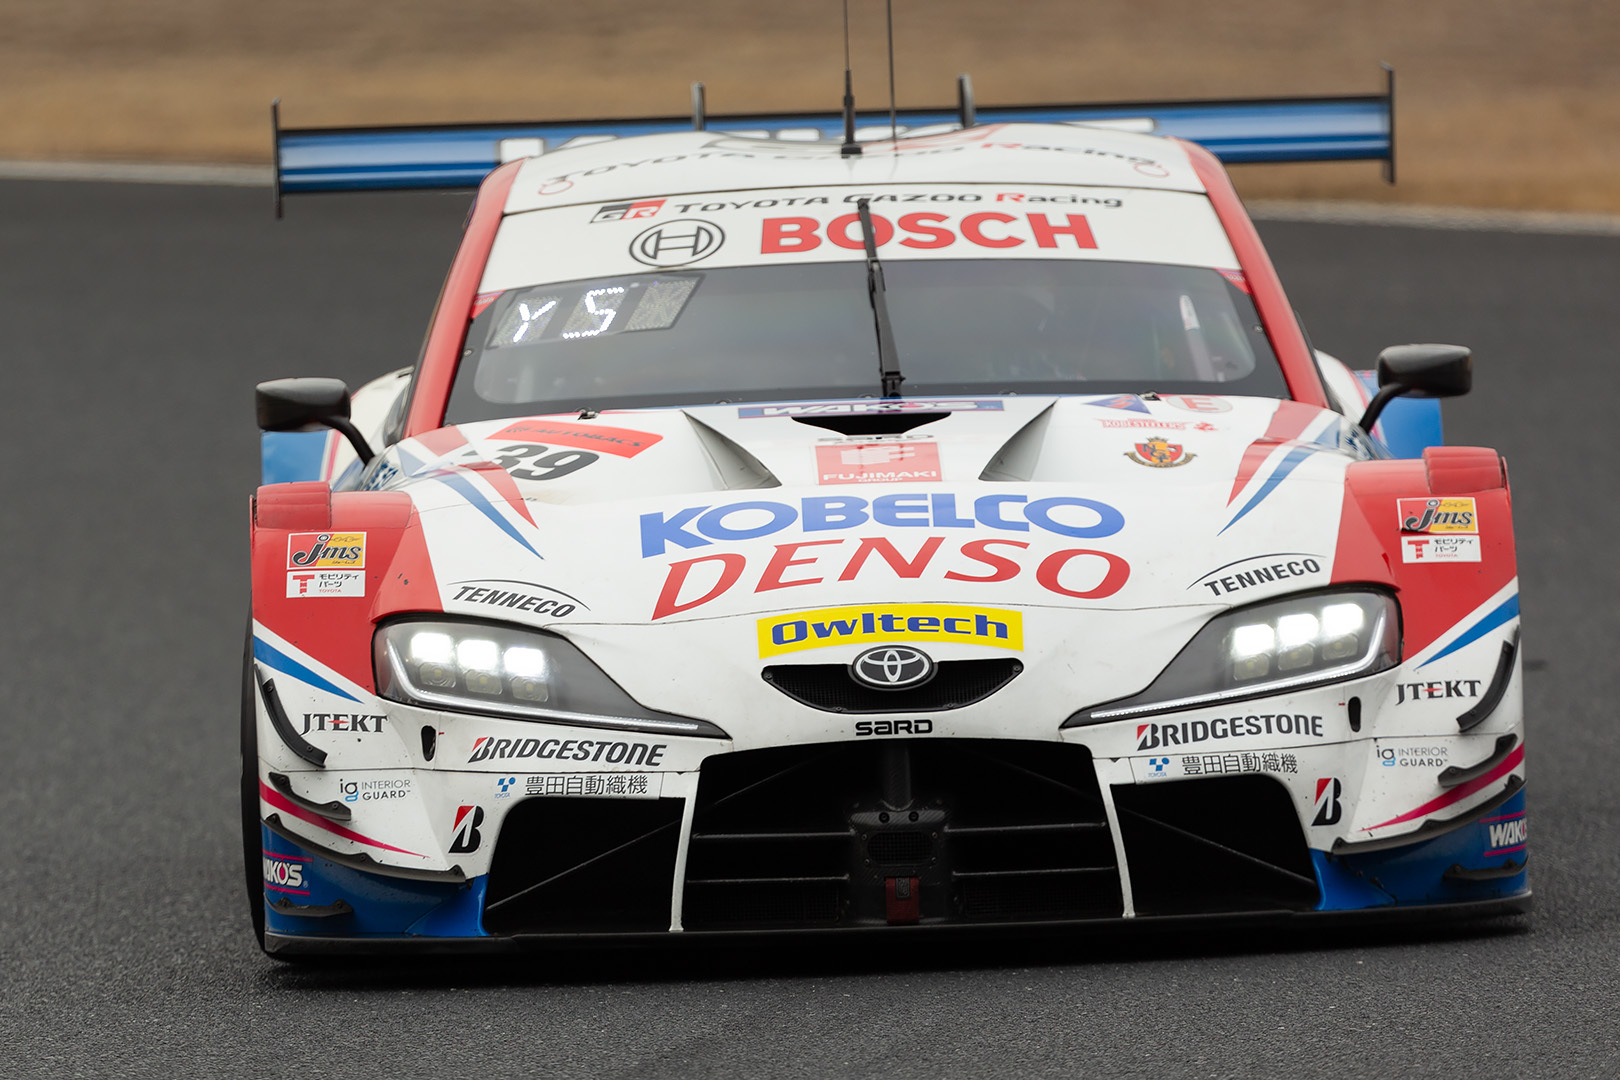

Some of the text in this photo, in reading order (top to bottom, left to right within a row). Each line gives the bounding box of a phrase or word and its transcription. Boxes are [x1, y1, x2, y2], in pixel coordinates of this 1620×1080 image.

[675, 192, 1123, 213] TOYOTA GAZOO Racing
[760, 211, 1099, 255] BOSCH
[823, 470, 937, 481] FUJIMAKI
[640, 492, 1126, 559] KOBELCO
[651, 536, 1131, 621] DENSO
[1203, 557, 1322, 597] TENNECO
[452, 585, 577, 619] TENNECO
[771, 612, 1009, 646] Owltech
[1395, 679, 1482, 706] JTEKT
[299, 713, 388, 737] JTEKT
[1136, 713, 1324, 752] BRIDGESTONE
[467, 735, 667, 767] BRIDGESTONE
[1181, 752, 1298, 776] 豊田自動織機
[1398, 746, 1449, 757] INTERIOR
[361, 779, 411, 790] INTERIOR
[524, 774, 649, 796] 豊田自動織機
